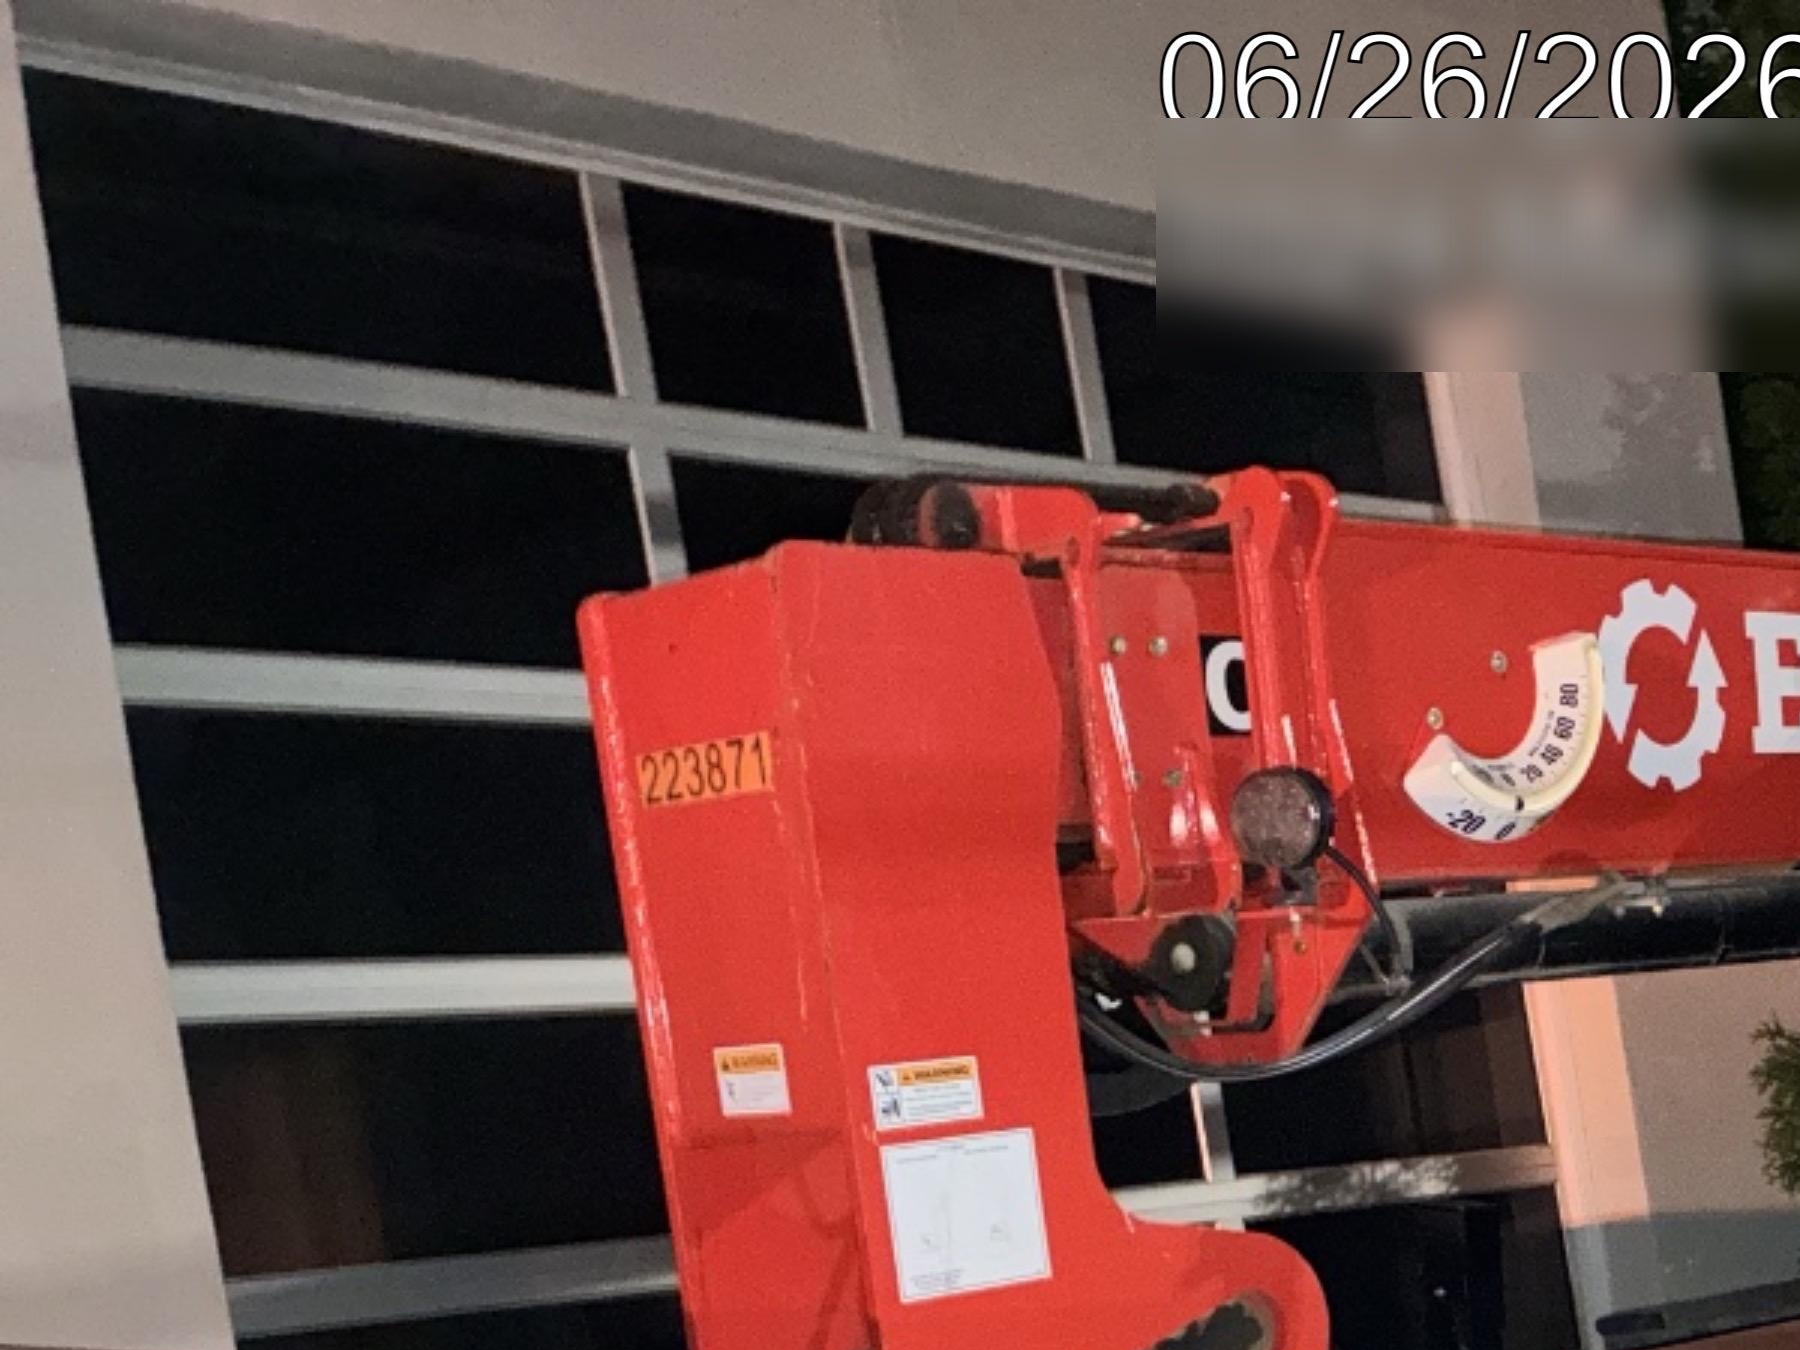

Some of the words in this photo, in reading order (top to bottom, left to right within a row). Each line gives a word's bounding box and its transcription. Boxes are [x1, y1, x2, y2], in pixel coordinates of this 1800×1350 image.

[1560, 683, 1578, 708] 80
[1554, 716, 1575, 740] 60
[1540, 743, 1564, 765] 40
[641, 735, 766, 804] 223871
[1520, 764, 1543, 783] 20
[1446, 809, 1486, 834] -20
